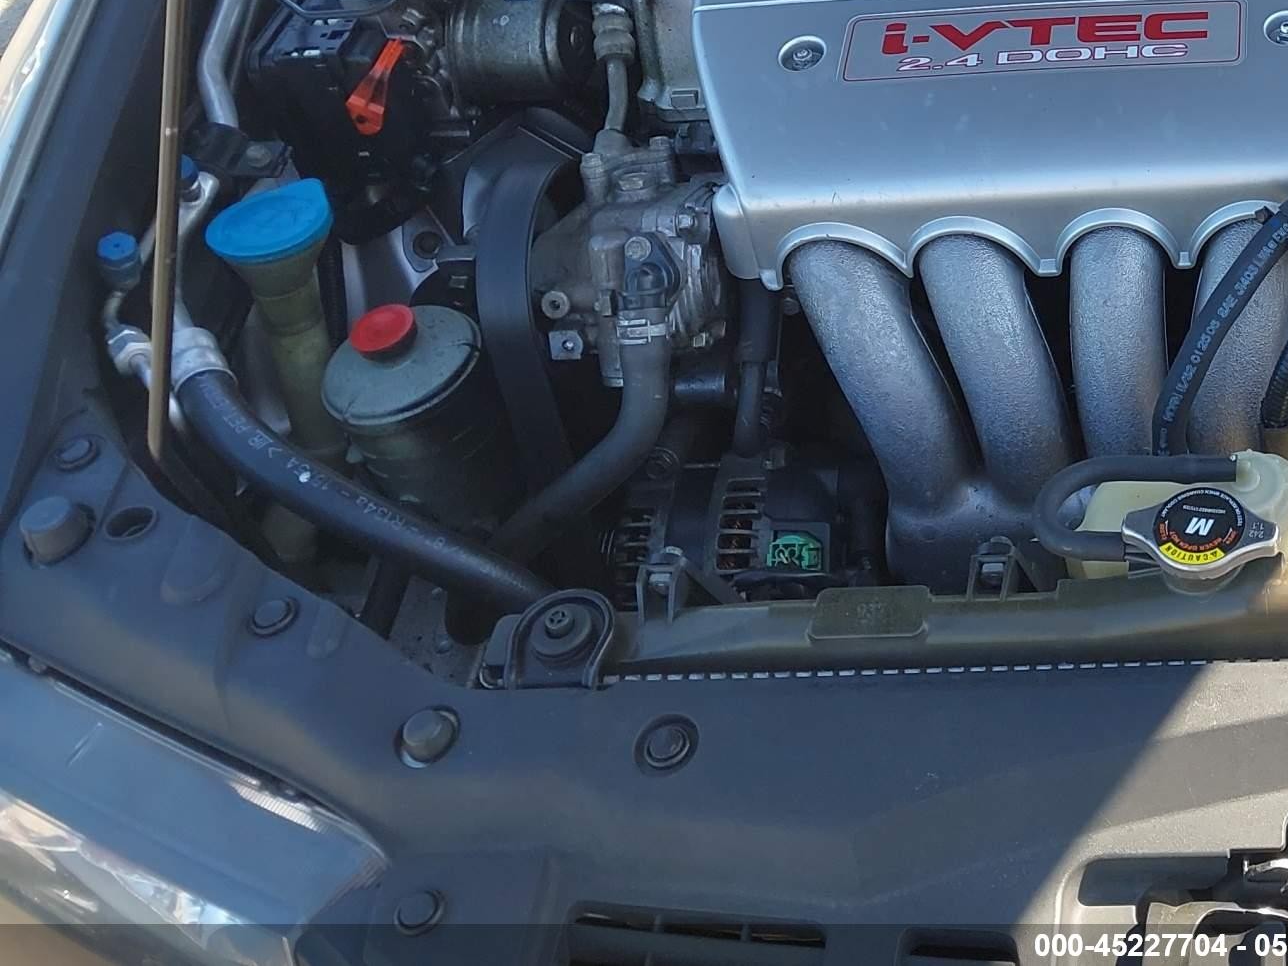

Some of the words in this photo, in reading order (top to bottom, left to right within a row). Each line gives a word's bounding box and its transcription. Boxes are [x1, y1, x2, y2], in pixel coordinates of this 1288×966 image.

[881, 11, 1209, 55] i-VTEC
[897, 53, 983, 72] 2.4
[996, 44, 1188, 65] DOHC
[1164, 544, 1208, 560] CAUTION
